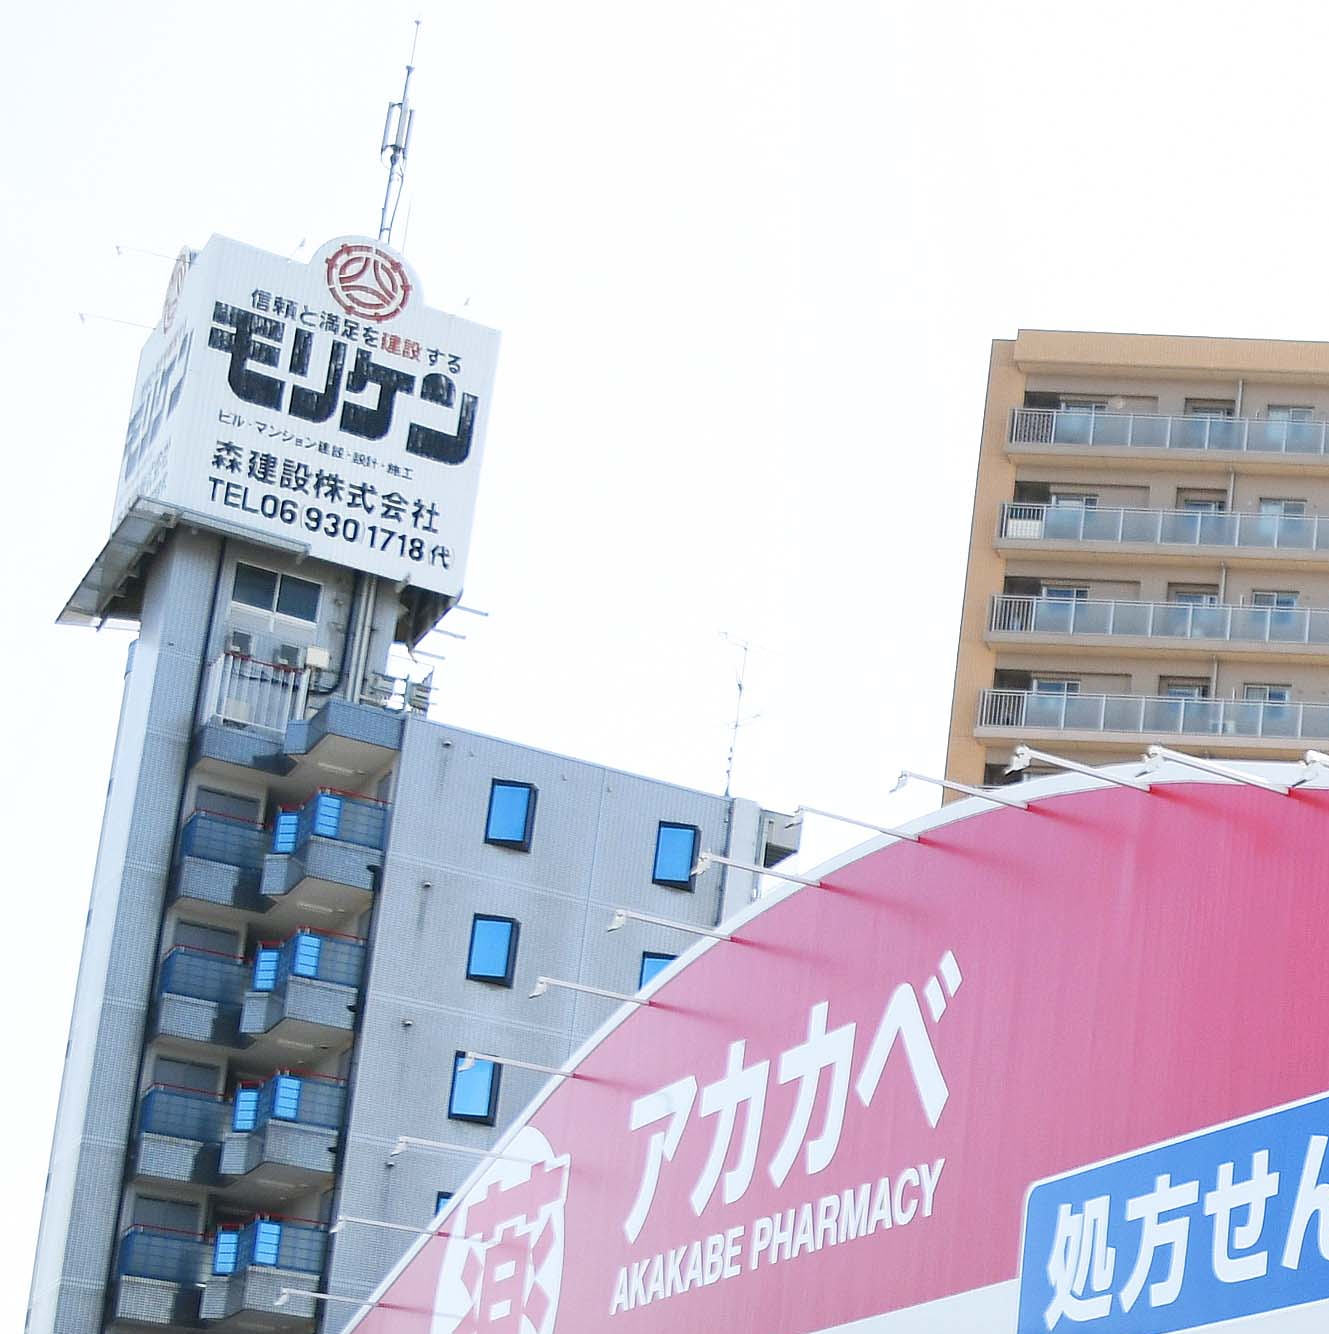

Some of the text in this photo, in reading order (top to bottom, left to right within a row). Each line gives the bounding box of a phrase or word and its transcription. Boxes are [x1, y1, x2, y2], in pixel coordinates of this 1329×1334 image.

[208, 300, 480, 465] モリケン
[250, 288, 462, 375] 信頼と満足を建設する
[210, 439, 441, 535] 森建設株式会社
[624, 950, 962, 1244] アカカベ
[610, 1158, 946, 1316] AKAKABE PHARMACY
